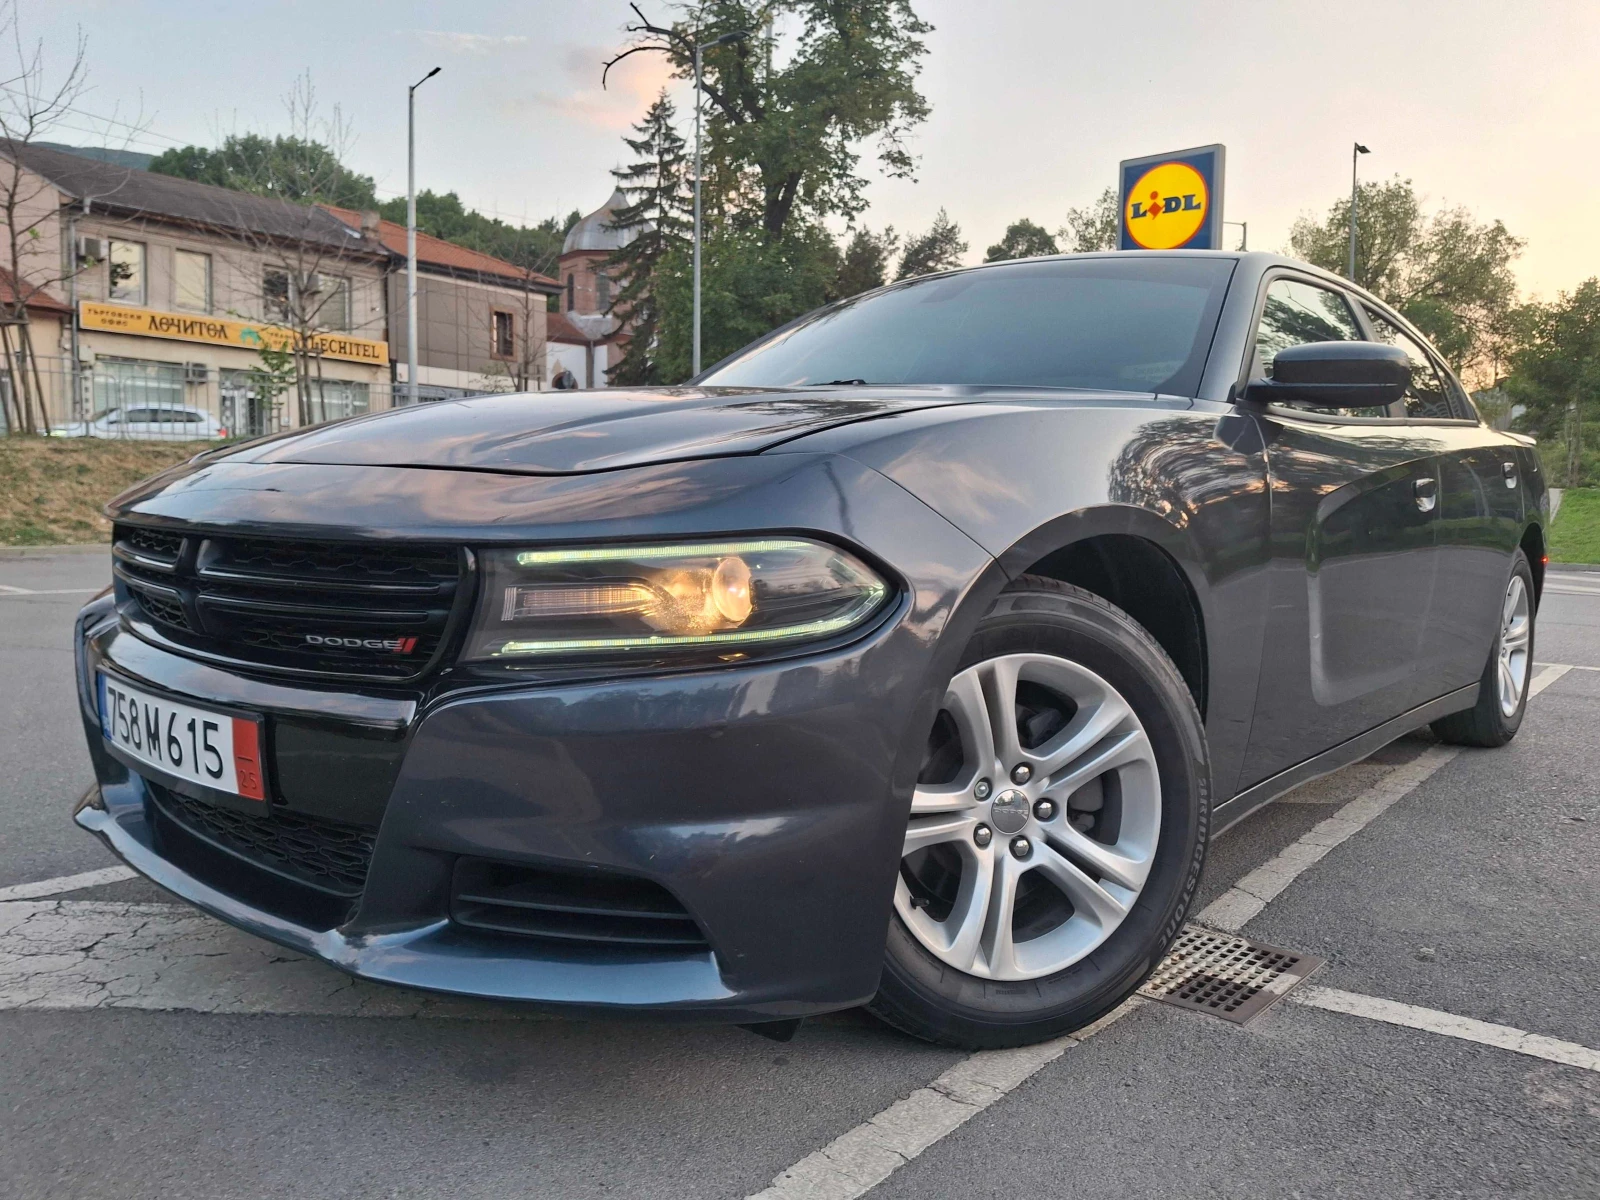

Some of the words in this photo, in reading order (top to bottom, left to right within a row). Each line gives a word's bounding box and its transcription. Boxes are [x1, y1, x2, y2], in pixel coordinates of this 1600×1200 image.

[100, 318, 128, 327] ОФИС
[305, 635, 402, 649] DODGE
[1158, 777, 1208, 950] BRIDGESTONE
